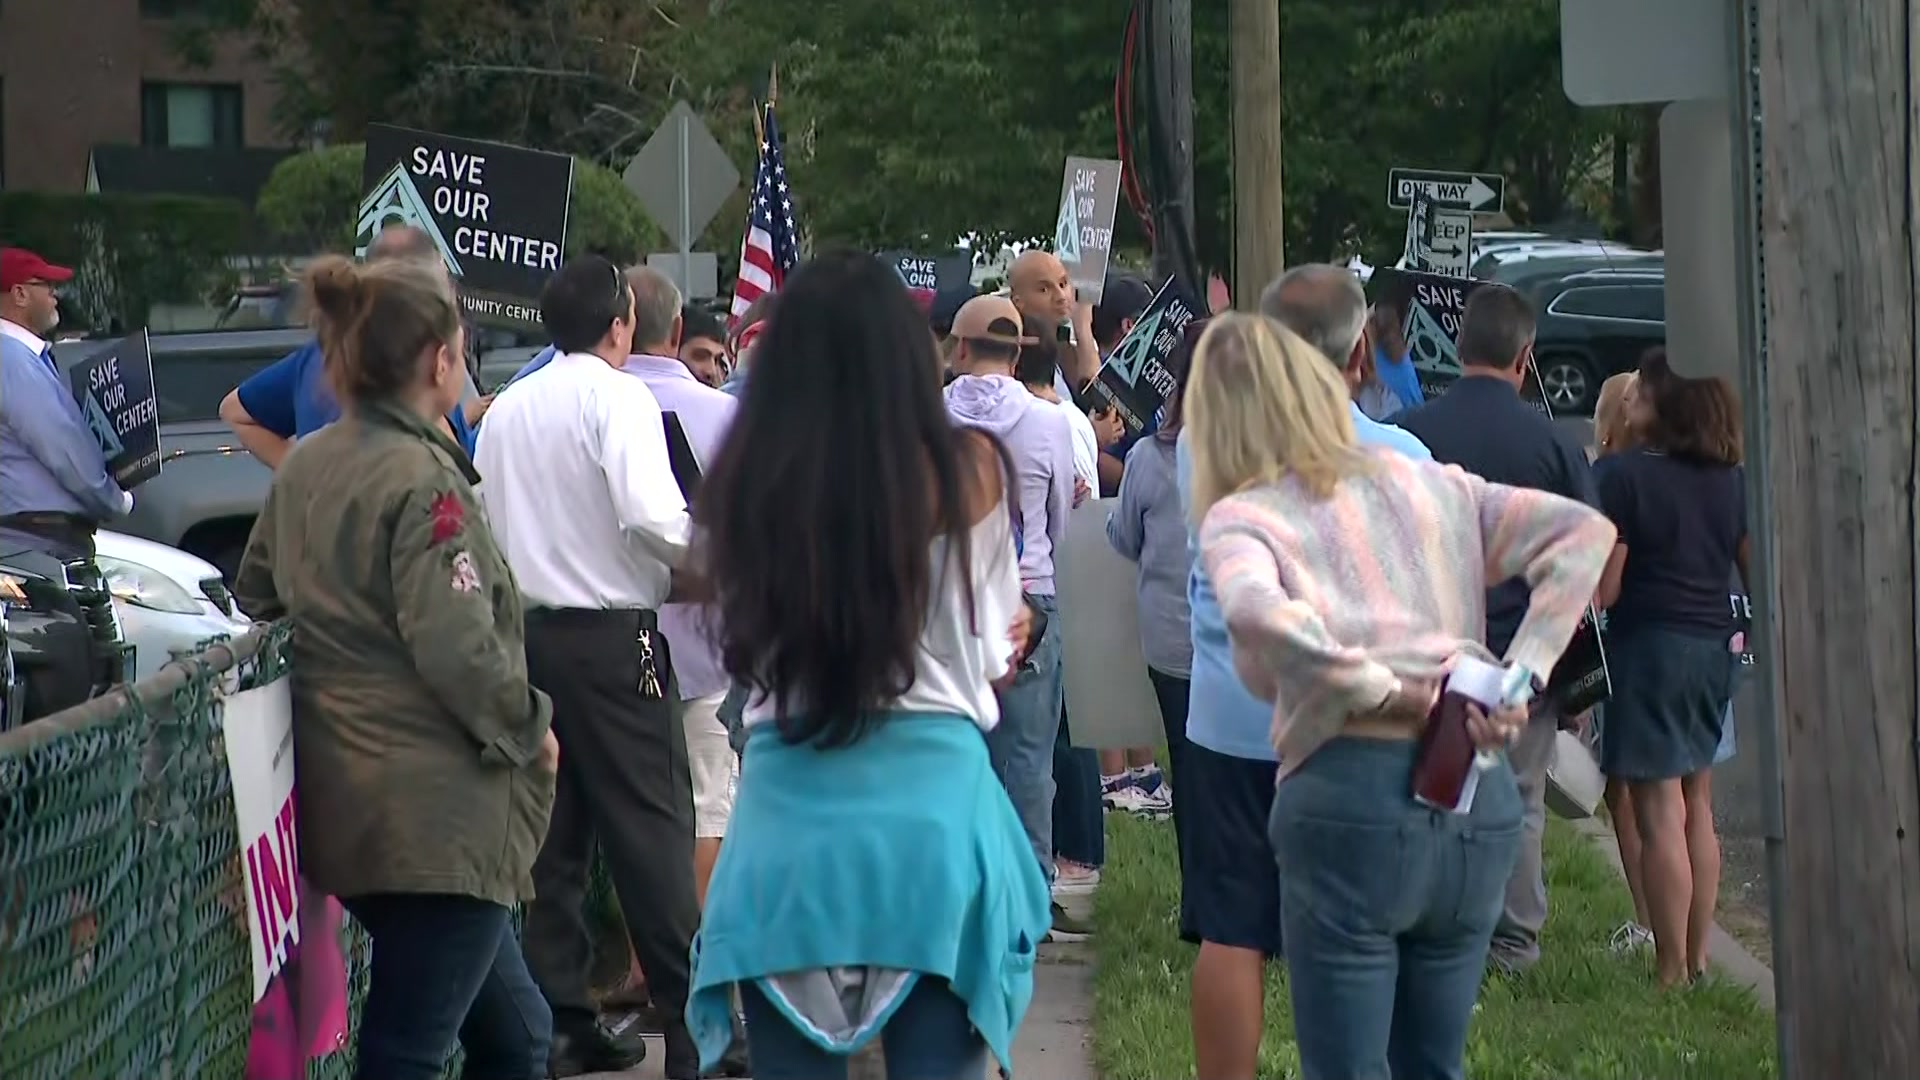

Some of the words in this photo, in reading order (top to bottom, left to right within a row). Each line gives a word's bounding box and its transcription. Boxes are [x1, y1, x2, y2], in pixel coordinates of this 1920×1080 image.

[412, 146, 486, 185] SAVE
[1075, 169, 1097, 192] SAVE
[1437, 184, 1468, 199] WAY
[434, 186, 490, 222] OUR
[1078, 197, 1095, 219] OUR
[1081, 226, 1111, 251] CENTER
[1433, 224, 1465, 239] EEP
[455, 226, 559, 271] CENTER
[901, 258, 935, 273] SAVE
[909, 272, 936, 287] OUR
[1417, 285, 1466, 309] SAVE
[506, 304, 543, 323] CENTE
[1441, 312, 1464, 333] OU
[89, 357, 119, 390] SAVE
[103, 384, 126, 412] OUR
[116, 398, 155, 436] CENTER
